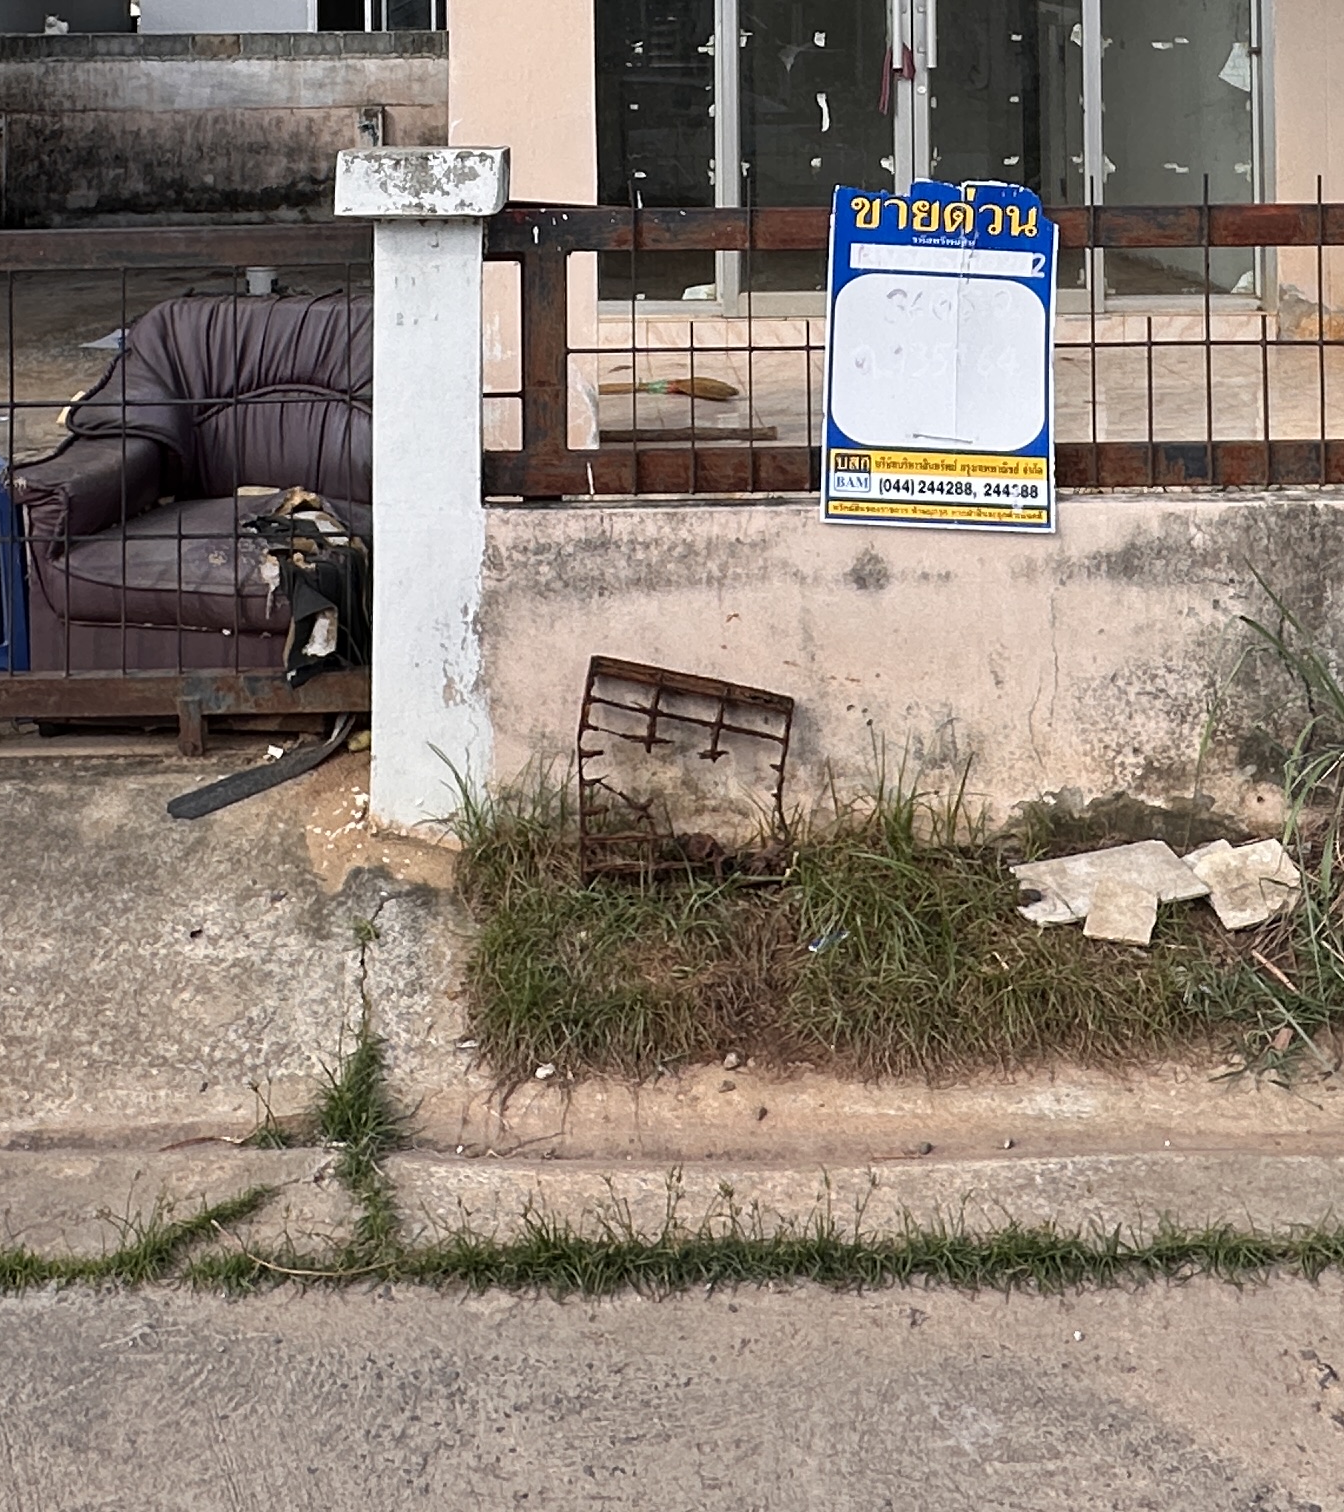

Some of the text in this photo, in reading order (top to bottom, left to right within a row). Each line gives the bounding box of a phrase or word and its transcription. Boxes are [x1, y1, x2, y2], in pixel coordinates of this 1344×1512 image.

[850, 187, 1038, 237] ขายด่วน
[836, 454, 869, 472] บสก
[836, 475, 869, 489] BAM
[879, 478, 915, 495] (044)
[918, 480, 977, 499] 244288,
